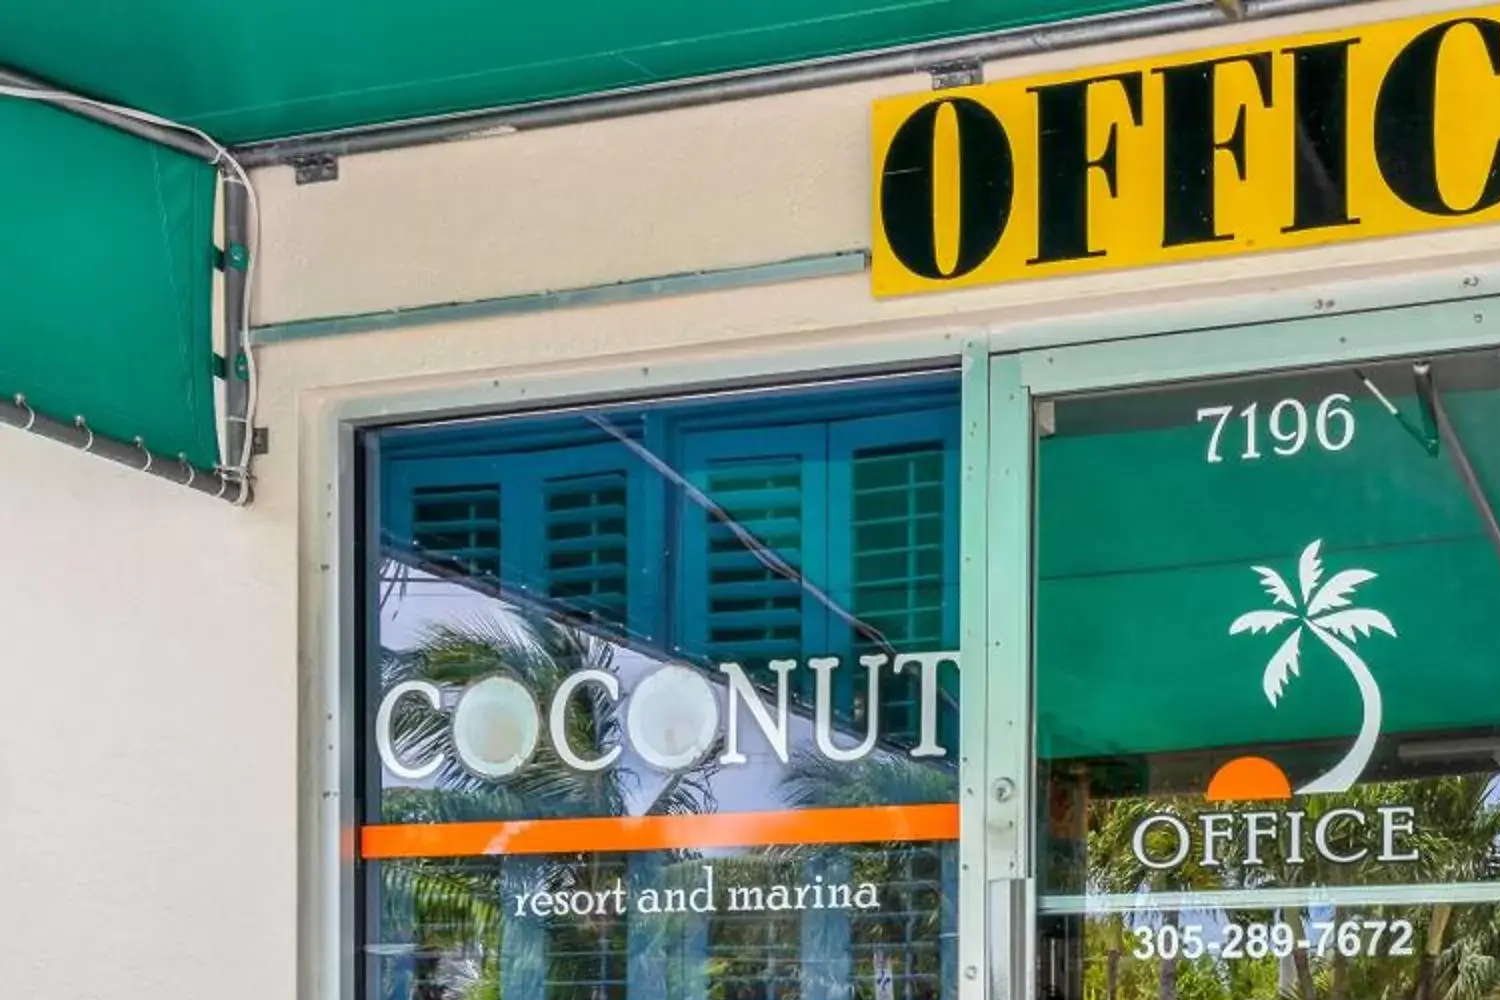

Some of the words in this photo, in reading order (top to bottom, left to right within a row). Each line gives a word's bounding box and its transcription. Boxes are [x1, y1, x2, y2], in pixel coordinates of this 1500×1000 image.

[1196, 393, 1356, 463] 7196
[374, 650, 961, 780] COCONUT
[1132, 804, 1420, 869] OFFICE
[513, 881, 627, 919] resort
[638, 866, 717, 914] and
[727, 875, 881, 913] marina
[1132, 919, 1414, 960] 305-289-7672
